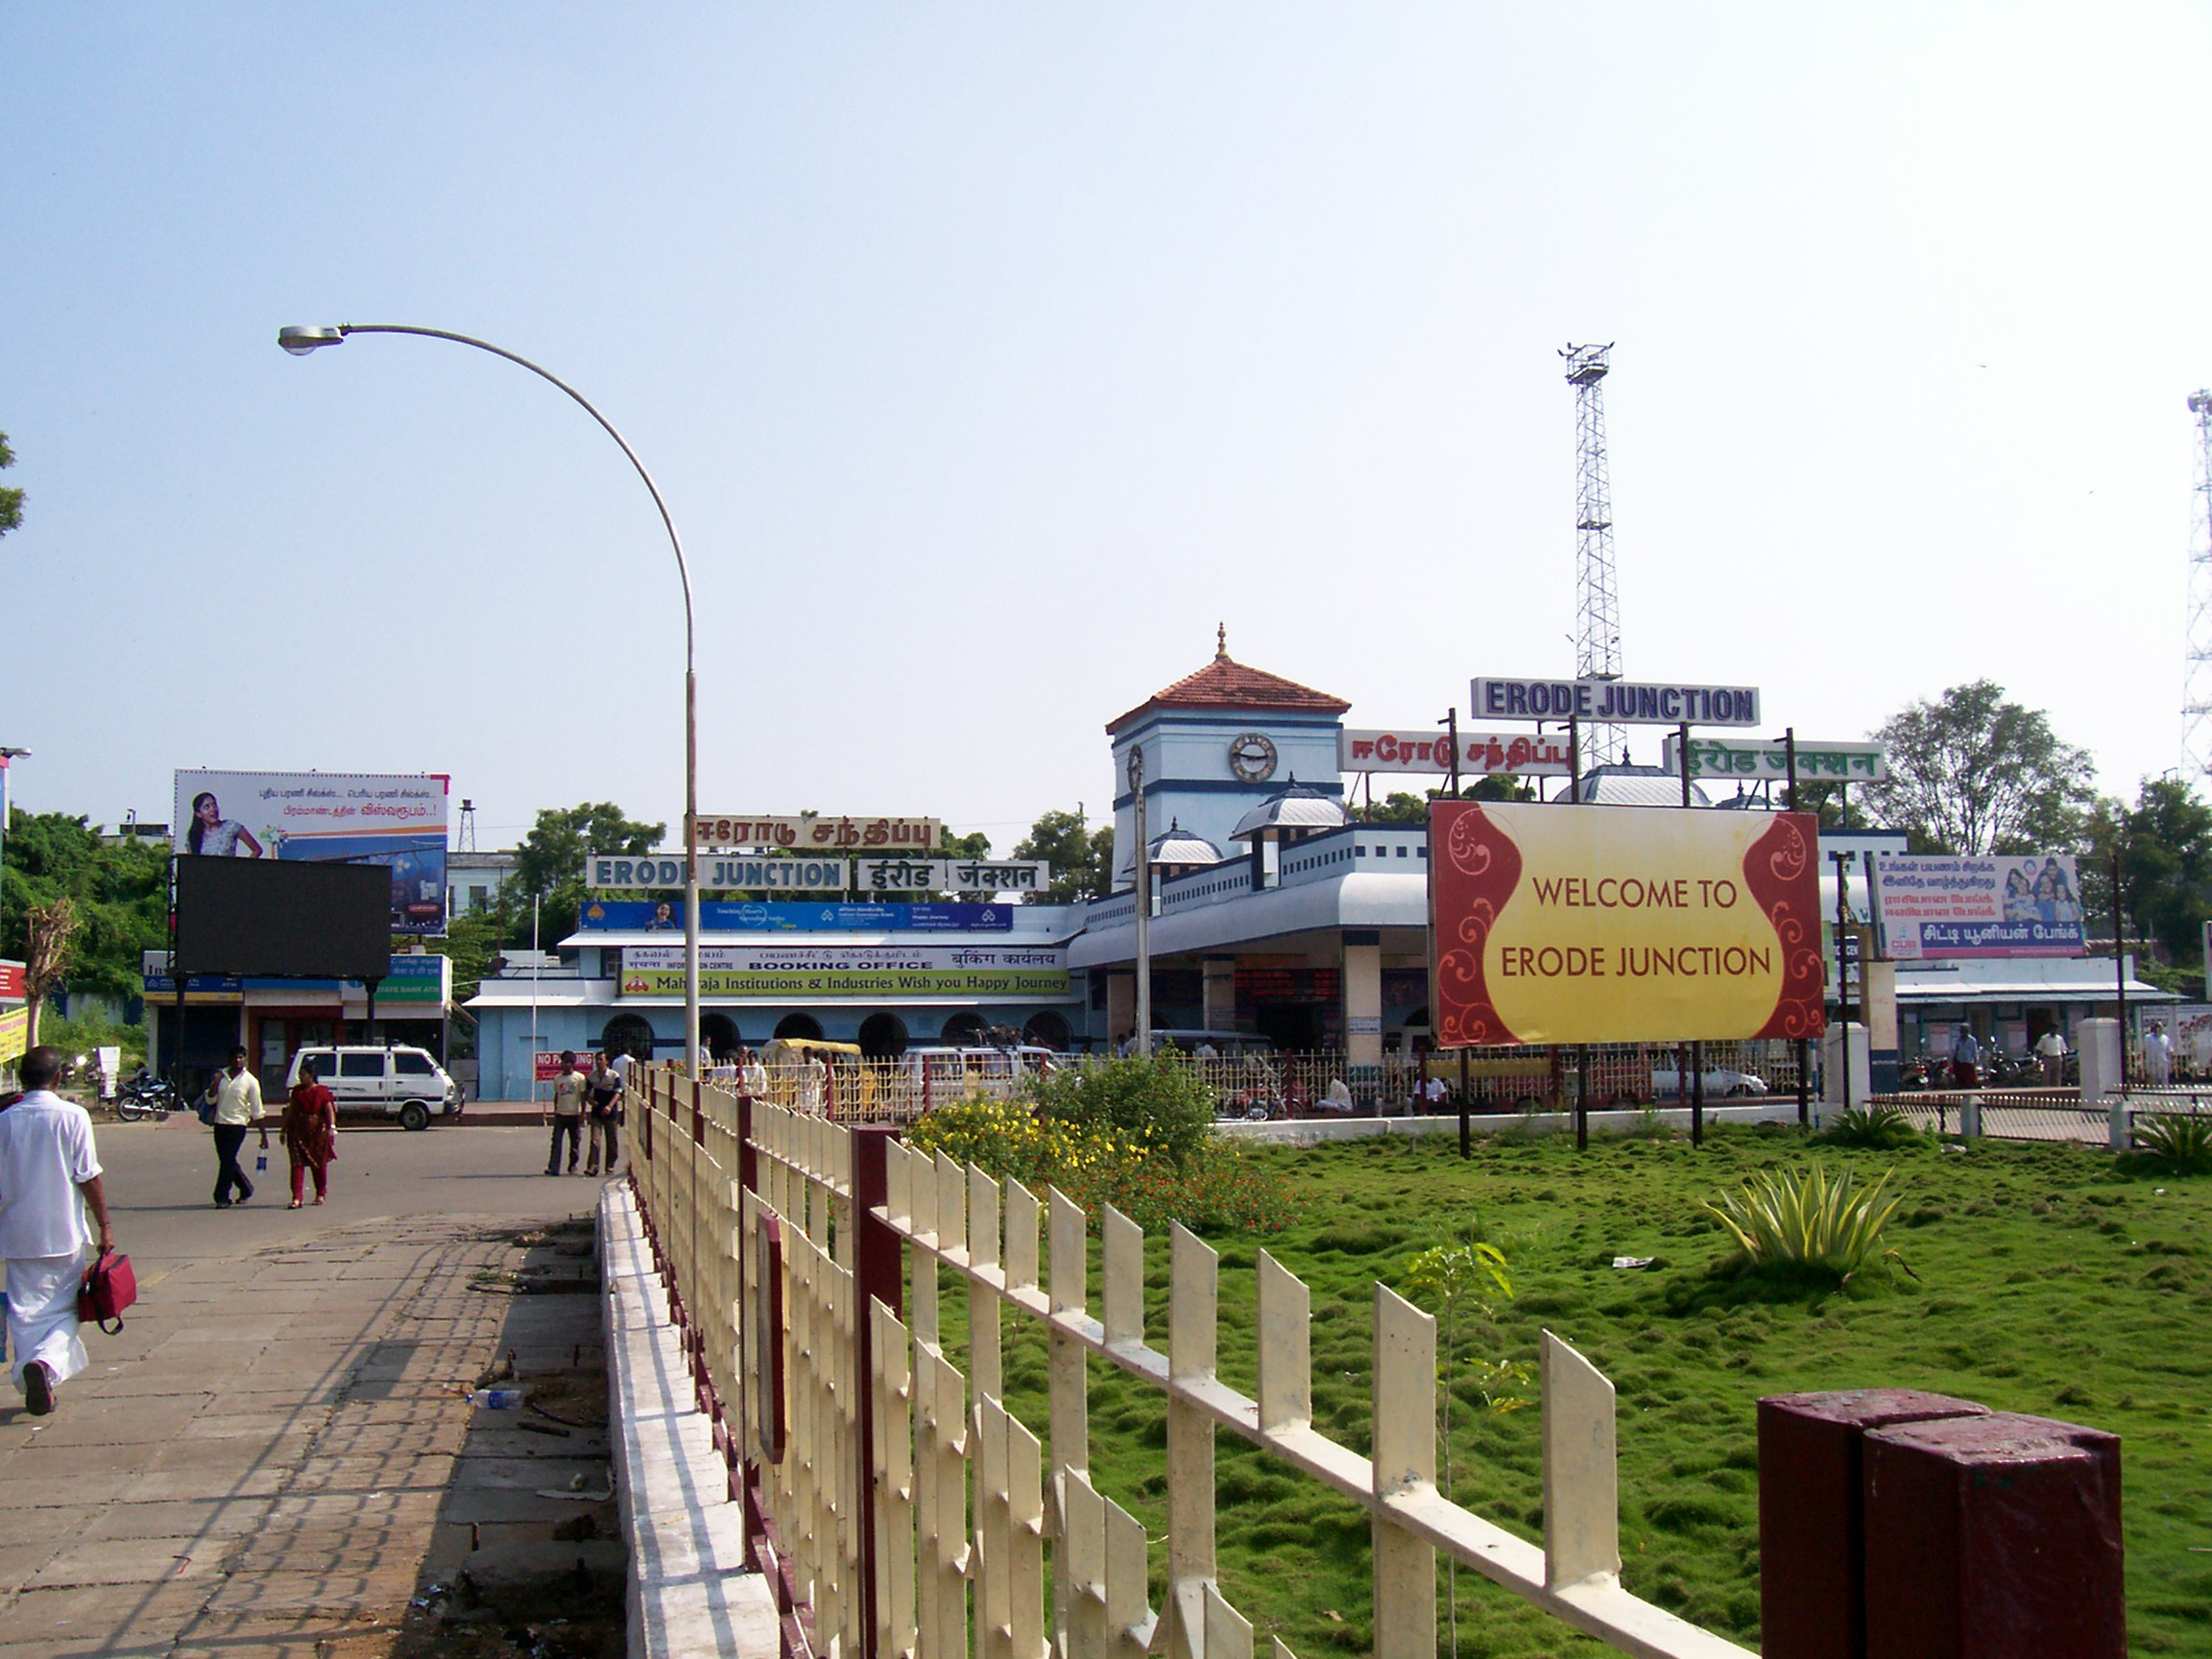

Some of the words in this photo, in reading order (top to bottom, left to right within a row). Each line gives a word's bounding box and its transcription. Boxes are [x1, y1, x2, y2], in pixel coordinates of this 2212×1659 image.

[1486, 681, 1592, 717] ERODE
[1598, 685, 1755, 721] JUNCTION
[812, 817, 931, 847] சந்திப்பு
[712, 862, 840, 886] JUNCTION
[957, 861, 1039, 888] जंक्शन
[1532, 878, 1688, 908] WELCOME
[1697, 879, 1737, 908] TO
[1923, 925, 1960, 944] சிட்டி
[1964, 924, 2029, 945] யூனியன்
[2032, 925, 2079, 940] பேங்க்
[749, 962, 850, 971] BOOKING
[857, 961, 934, 970] OFFICE
[951, 949, 996, 969] बुकिंग
[1502, 946, 1605, 977] ERODE
[1616, 946, 1770, 977] JUNCTION
[657, 976, 720, 991] Mahaja
[726, 976, 804, 990] Institutions
[808, 978, 821, 990] &
[828, 976, 893, 989] Industries
[899, 976, 930, 989] Wish
[936, 980, 961, 990] you
[967, 976, 1009, 990] Happy
[1015, 975, 1067, 990] Journey
[538, 1054, 551, 1064] NO
[553, 1054, 592, 1064] PAING
